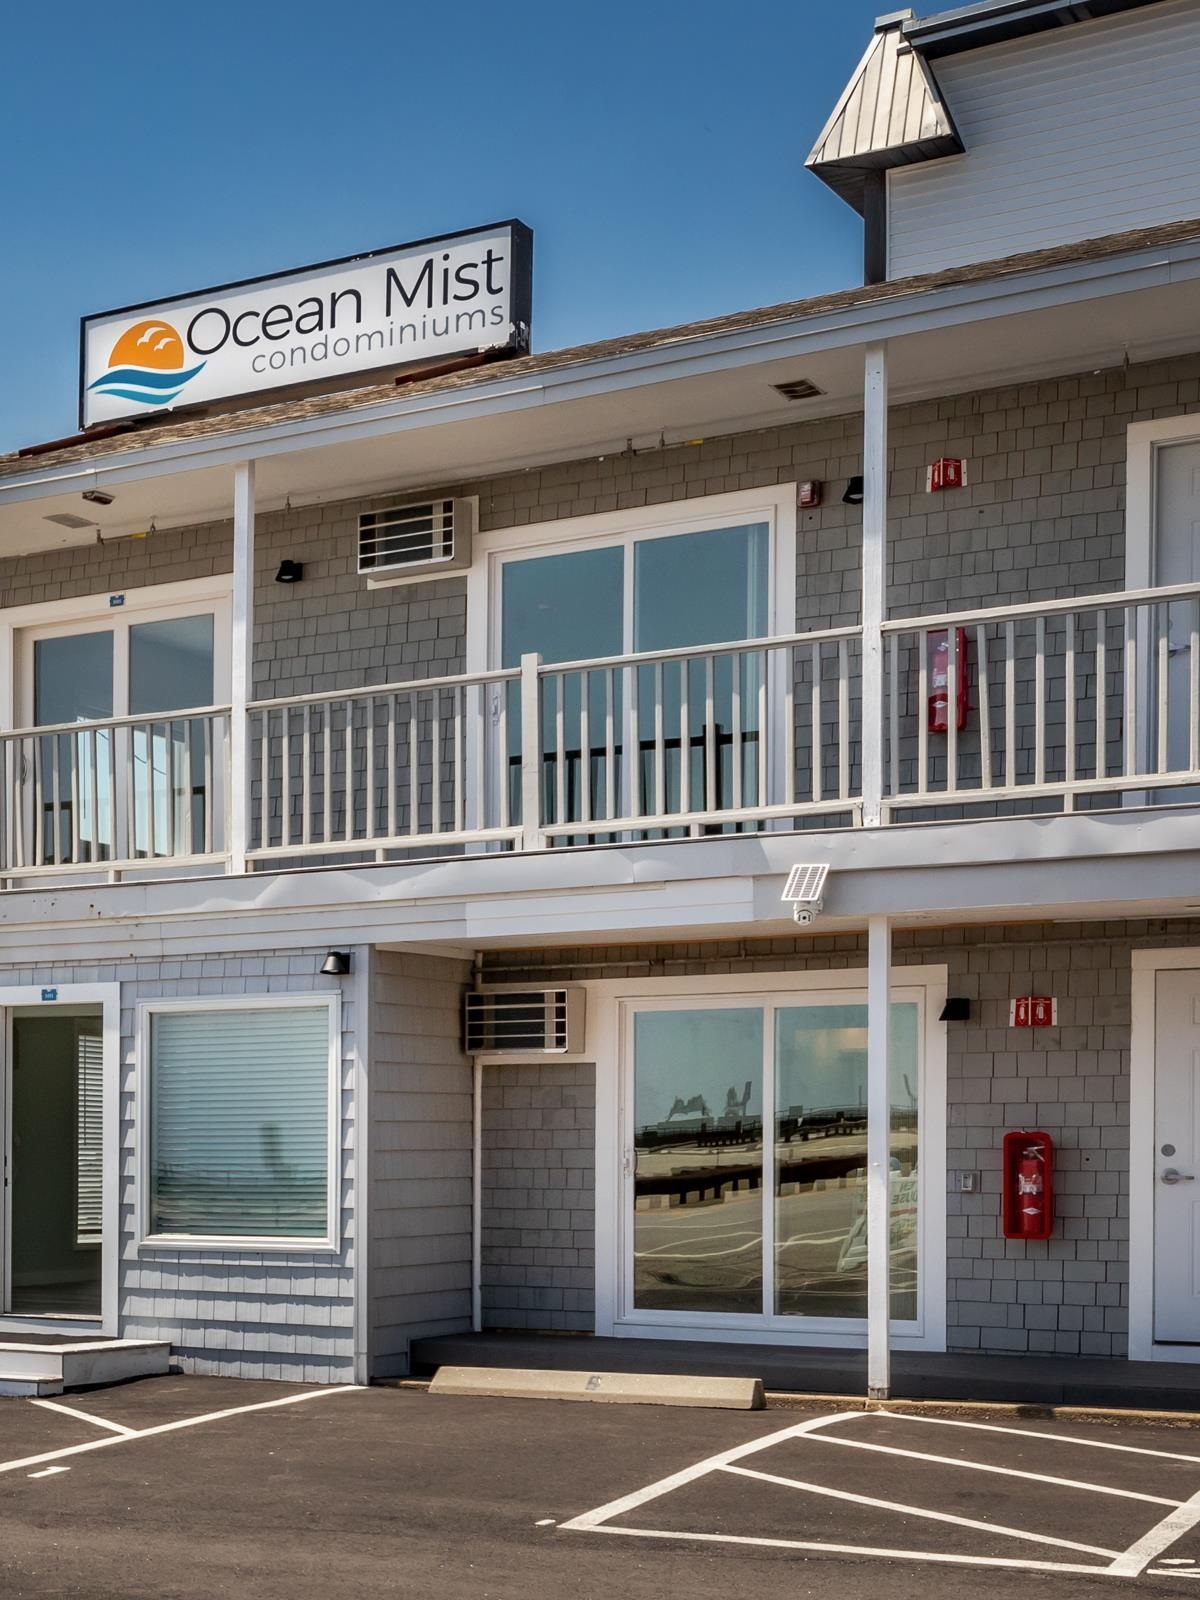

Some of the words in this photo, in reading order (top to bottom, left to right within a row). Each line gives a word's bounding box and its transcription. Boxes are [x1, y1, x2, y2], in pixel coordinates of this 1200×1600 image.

[187, 288, 362, 356] Ocean
[385, 248, 505, 318] Mist
[251, 304, 505, 374] condominiums
